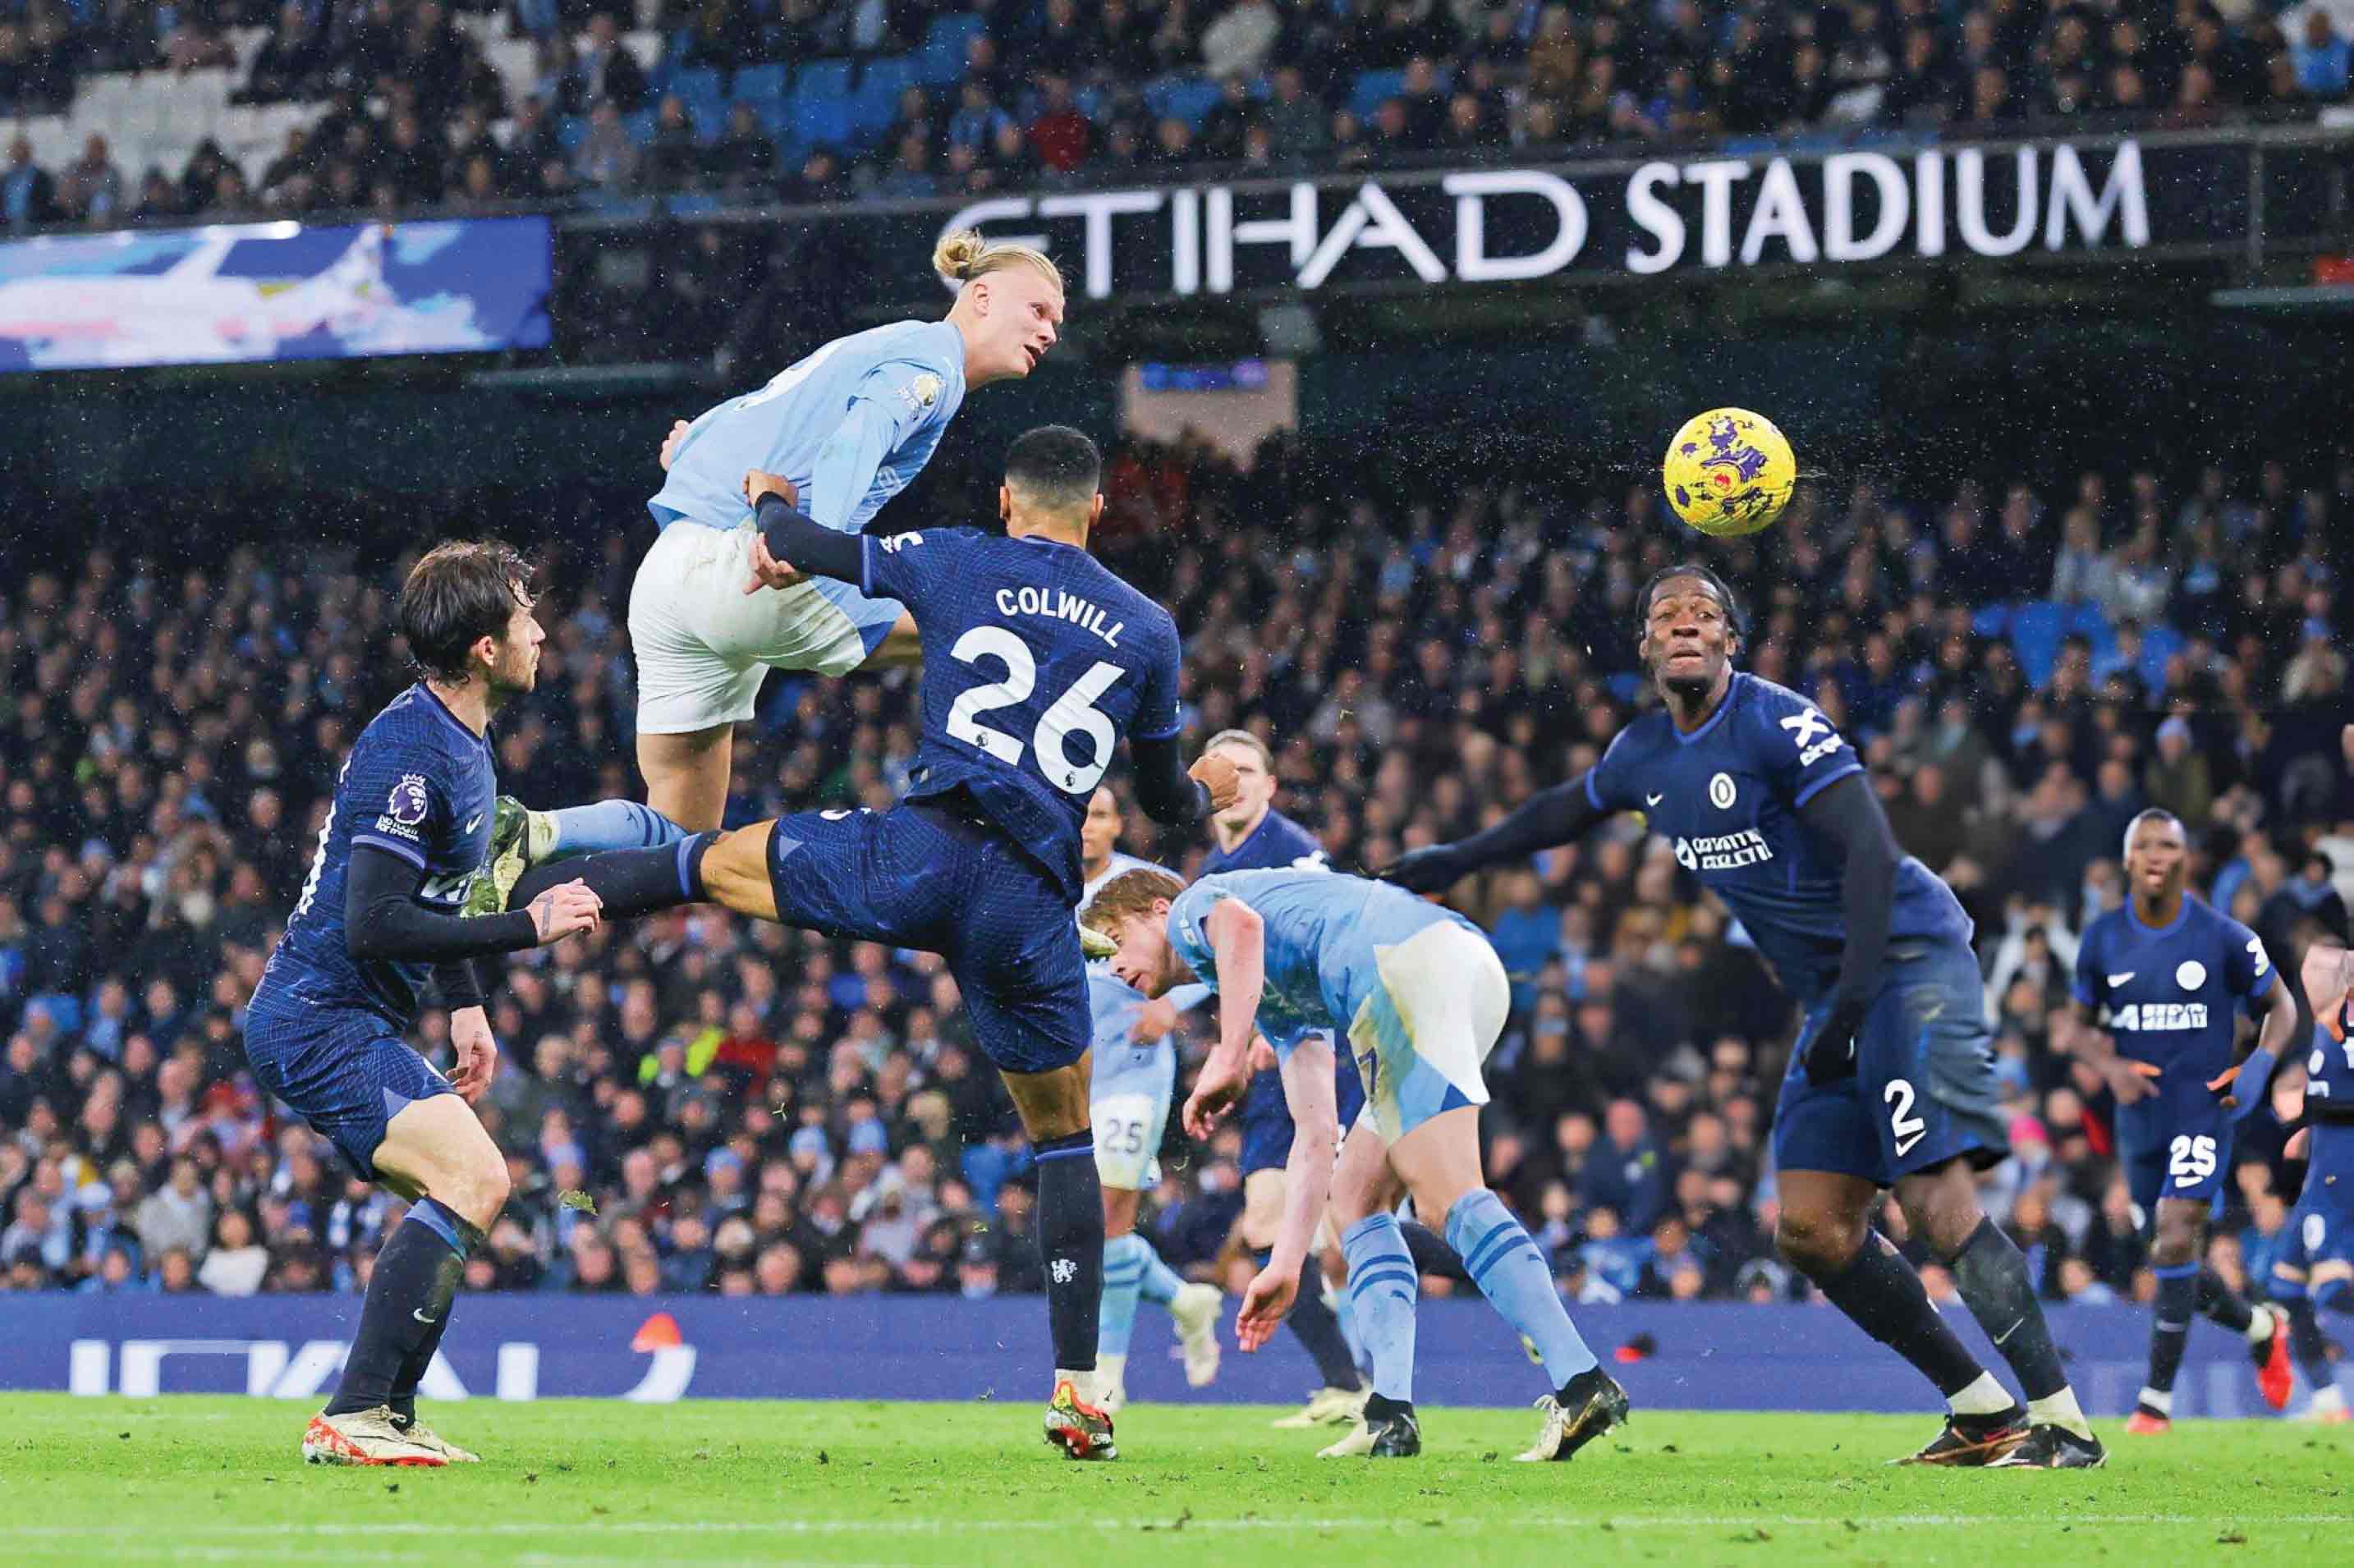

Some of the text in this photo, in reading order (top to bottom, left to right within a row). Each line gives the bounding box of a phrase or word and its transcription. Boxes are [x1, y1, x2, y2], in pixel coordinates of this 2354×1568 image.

[942, 140, 2149, 299] ETIHAD STADIUM
[995, 586, 1125, 648] COLWILL
[945, 625, 1126, 795] 26
[1104, 1118, 1143, 1154] 25
[1884, 1079, 1925, 1138] 2
[2169, 1135, 2217, 1179] 25
